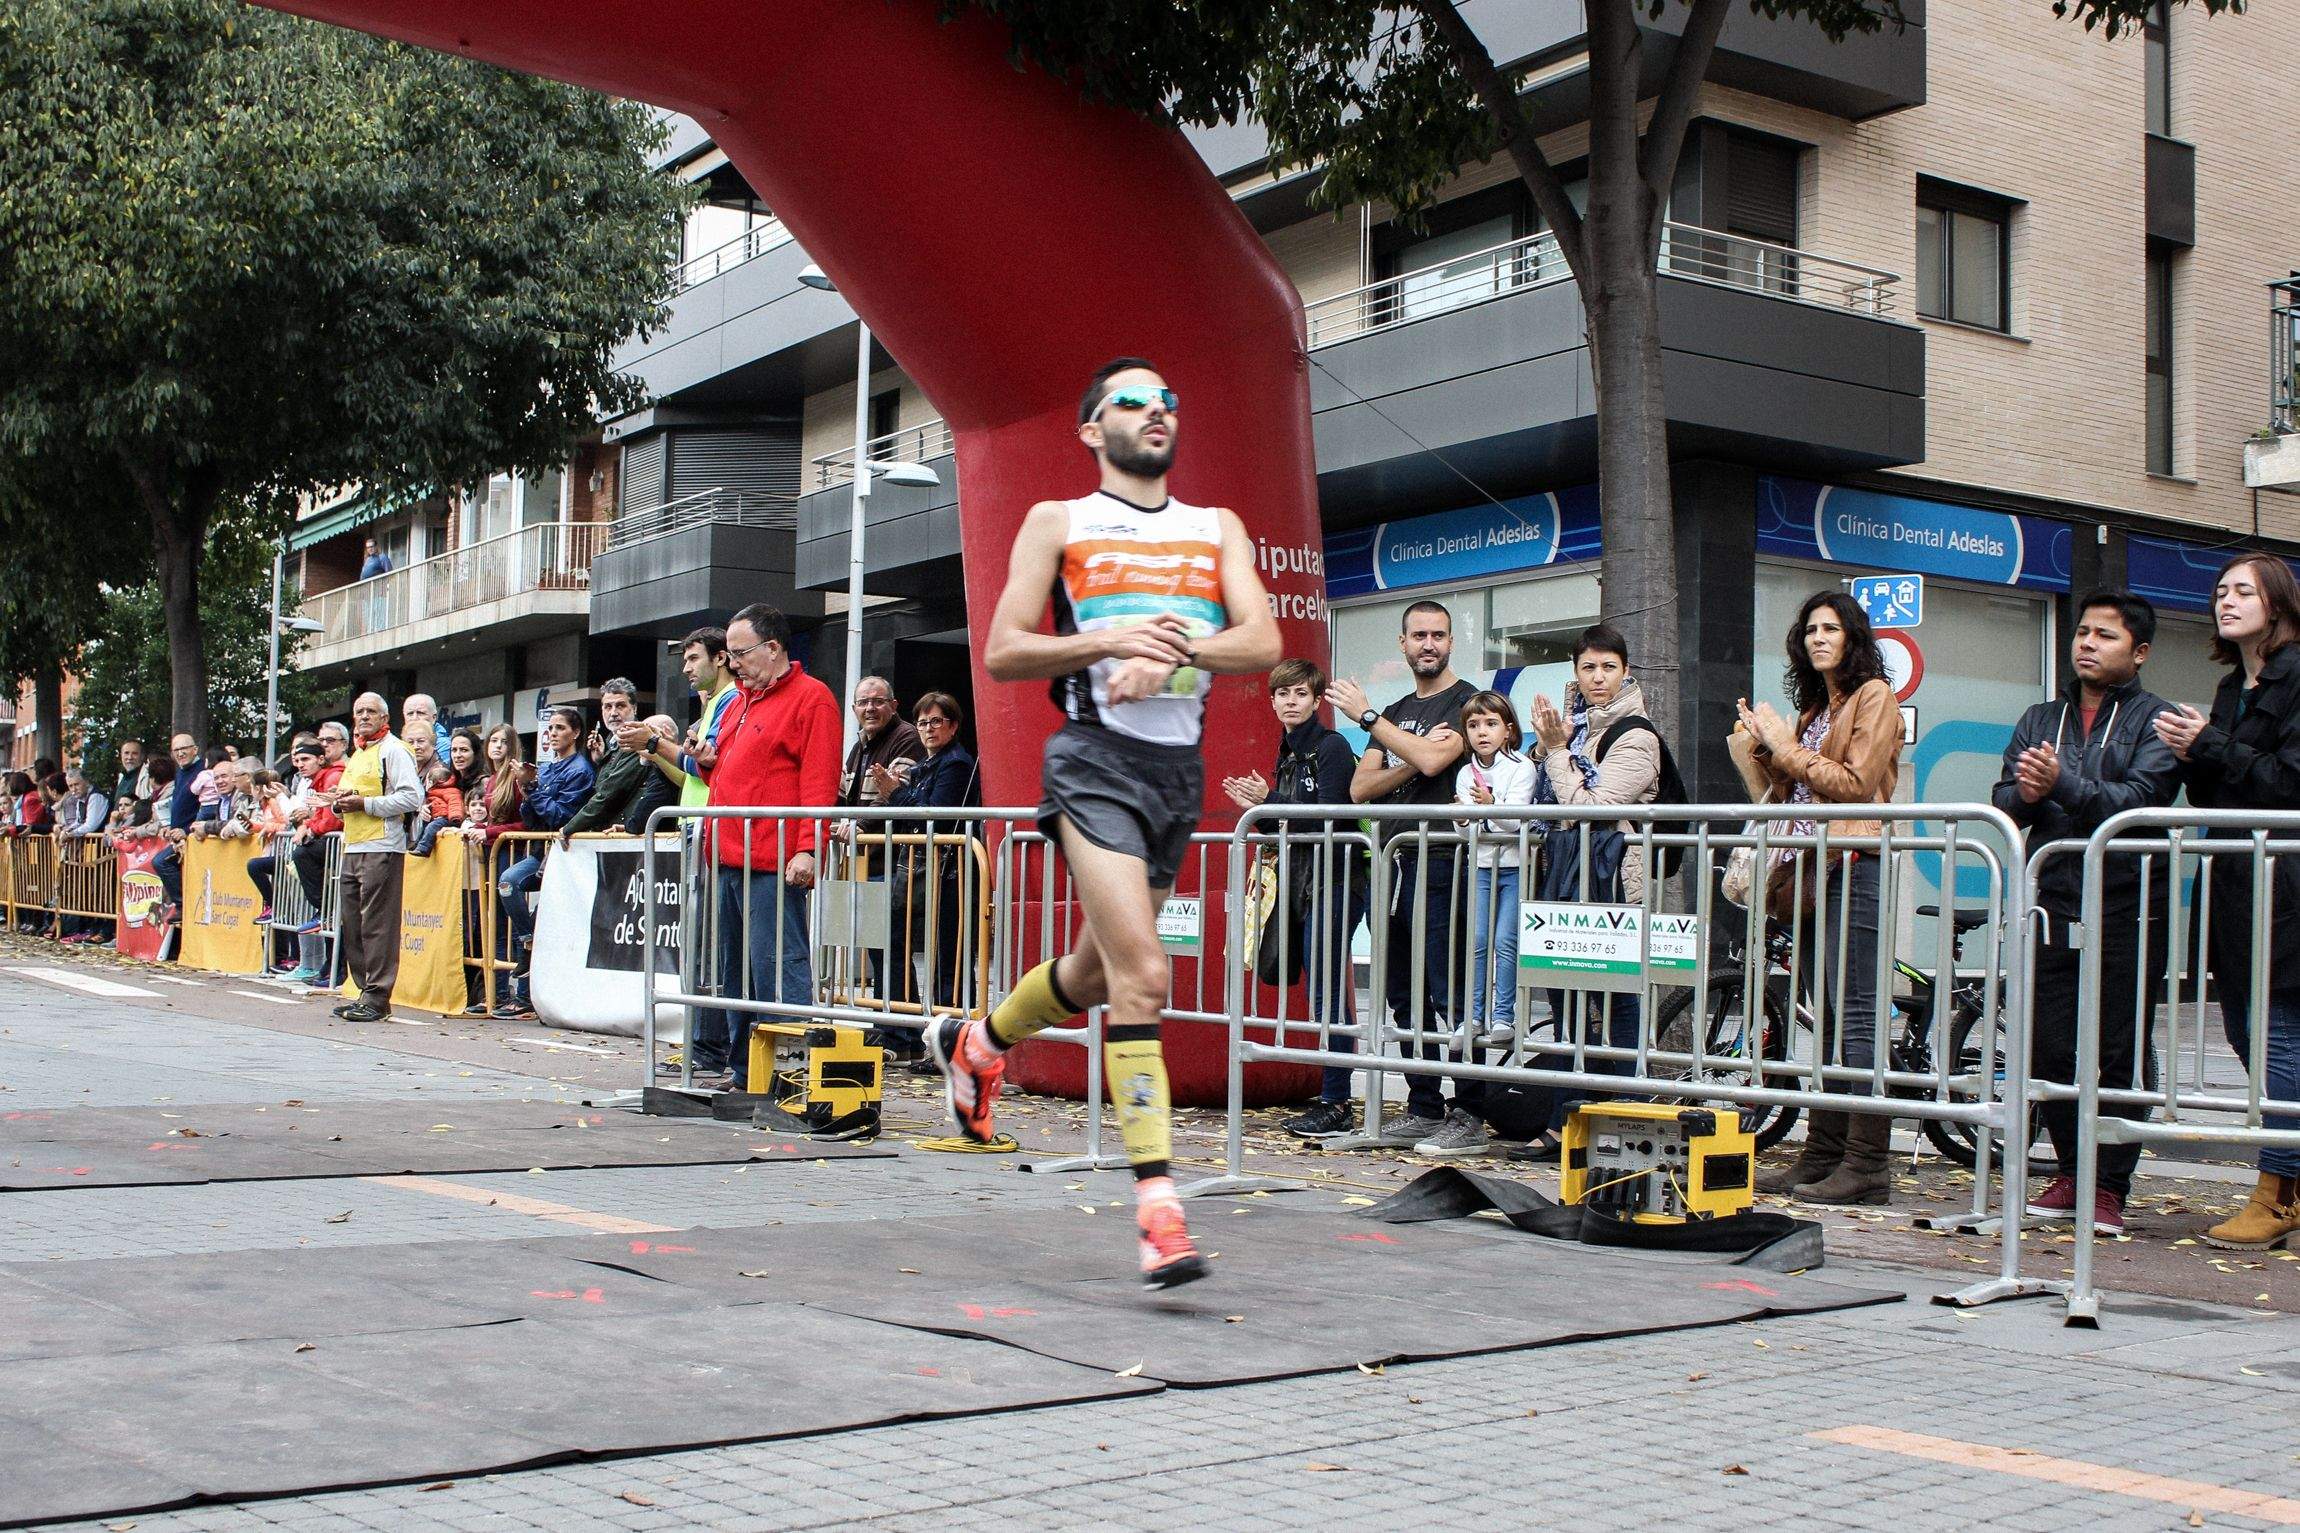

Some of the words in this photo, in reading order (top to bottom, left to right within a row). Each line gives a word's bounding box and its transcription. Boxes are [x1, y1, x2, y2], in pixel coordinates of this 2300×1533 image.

[1390, 541, 1433, 563] Clínica
[1437, 529, 1482, 556] Dental
[1486, 522, 1541, 548] Adeslas
[1837, 514, 1888, 541] Clínica
[1893, 522, 1944, 548] Dental
[1947, 531, 2004, 557] Adeslas
[1266, 589, 1327, 623] arcelo
[1160, 903, 1197, 915] NMAVA
[1549, 911, 1637, 930] INMAVA
[1651, 918, 1697, 934] MAVA
[614, 914, 634, 945] de
[636, 915, 678, 948] Snt
[1557, 940, 1568, 952] 93
[1571, 941, 1588, 953] 336
[1591, 942, 1602, 953] 97
[1605, 944, 1616, 955] 65
[1664, 944, 1672, 953] 97
[1552, 959, 1608, 969] www.inmava.com
